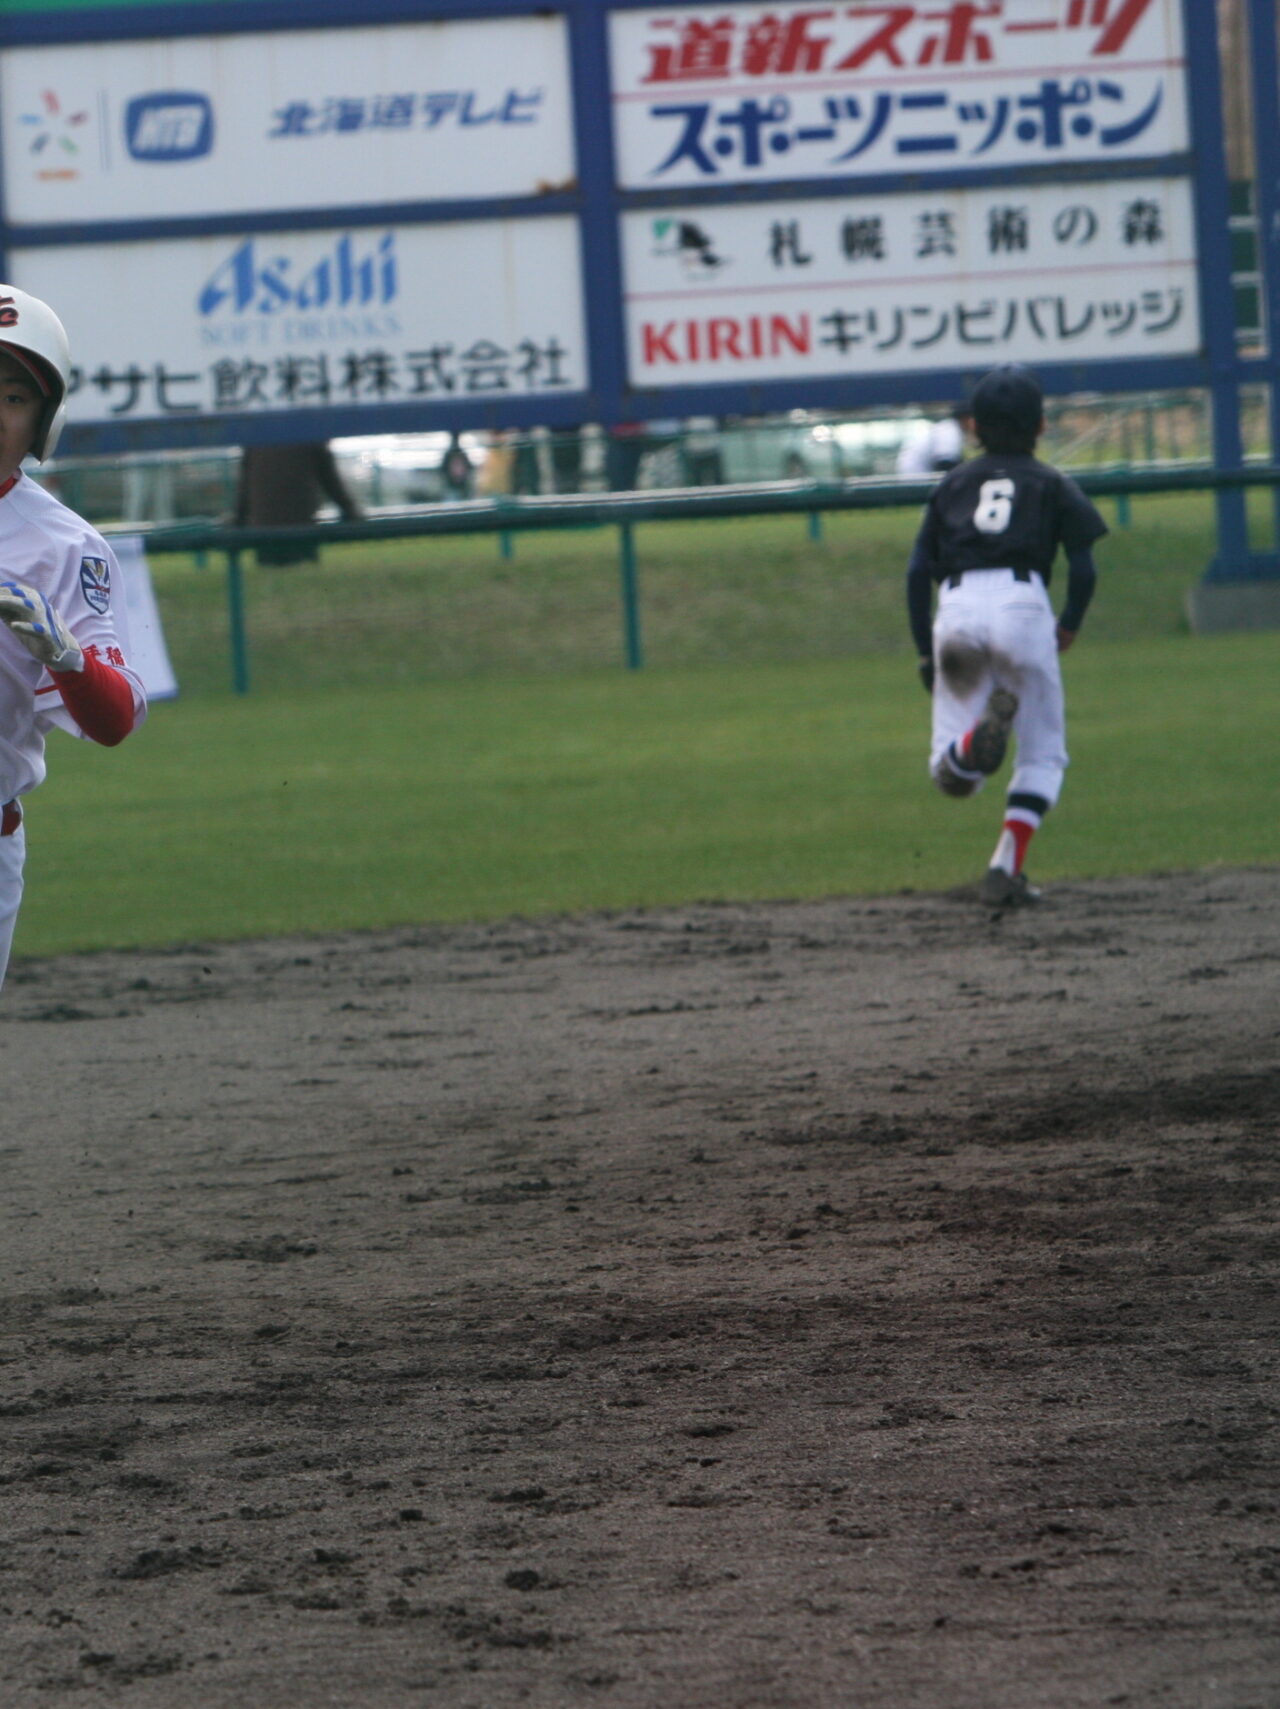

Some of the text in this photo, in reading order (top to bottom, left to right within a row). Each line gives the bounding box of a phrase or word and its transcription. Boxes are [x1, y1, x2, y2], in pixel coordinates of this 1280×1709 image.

[639, 0, 1152, 84] 道新スポーツ
[269, 87, 543, 139] 北海道テレビ
[647, 77, 1164, 177] スポーツニッポン
[768, 197, 1165, 268] 札幌芸術の森
[199, 231, 399, 316] Asahi
[201, 312, 403, 345] SOFT DRINKS
[641, 287, 1183, 365] KIRIN キリンビバレッジ
[67, 336, 573, 415] サヒ飲料株式会社
[973, 478, 1015, 534] 6
